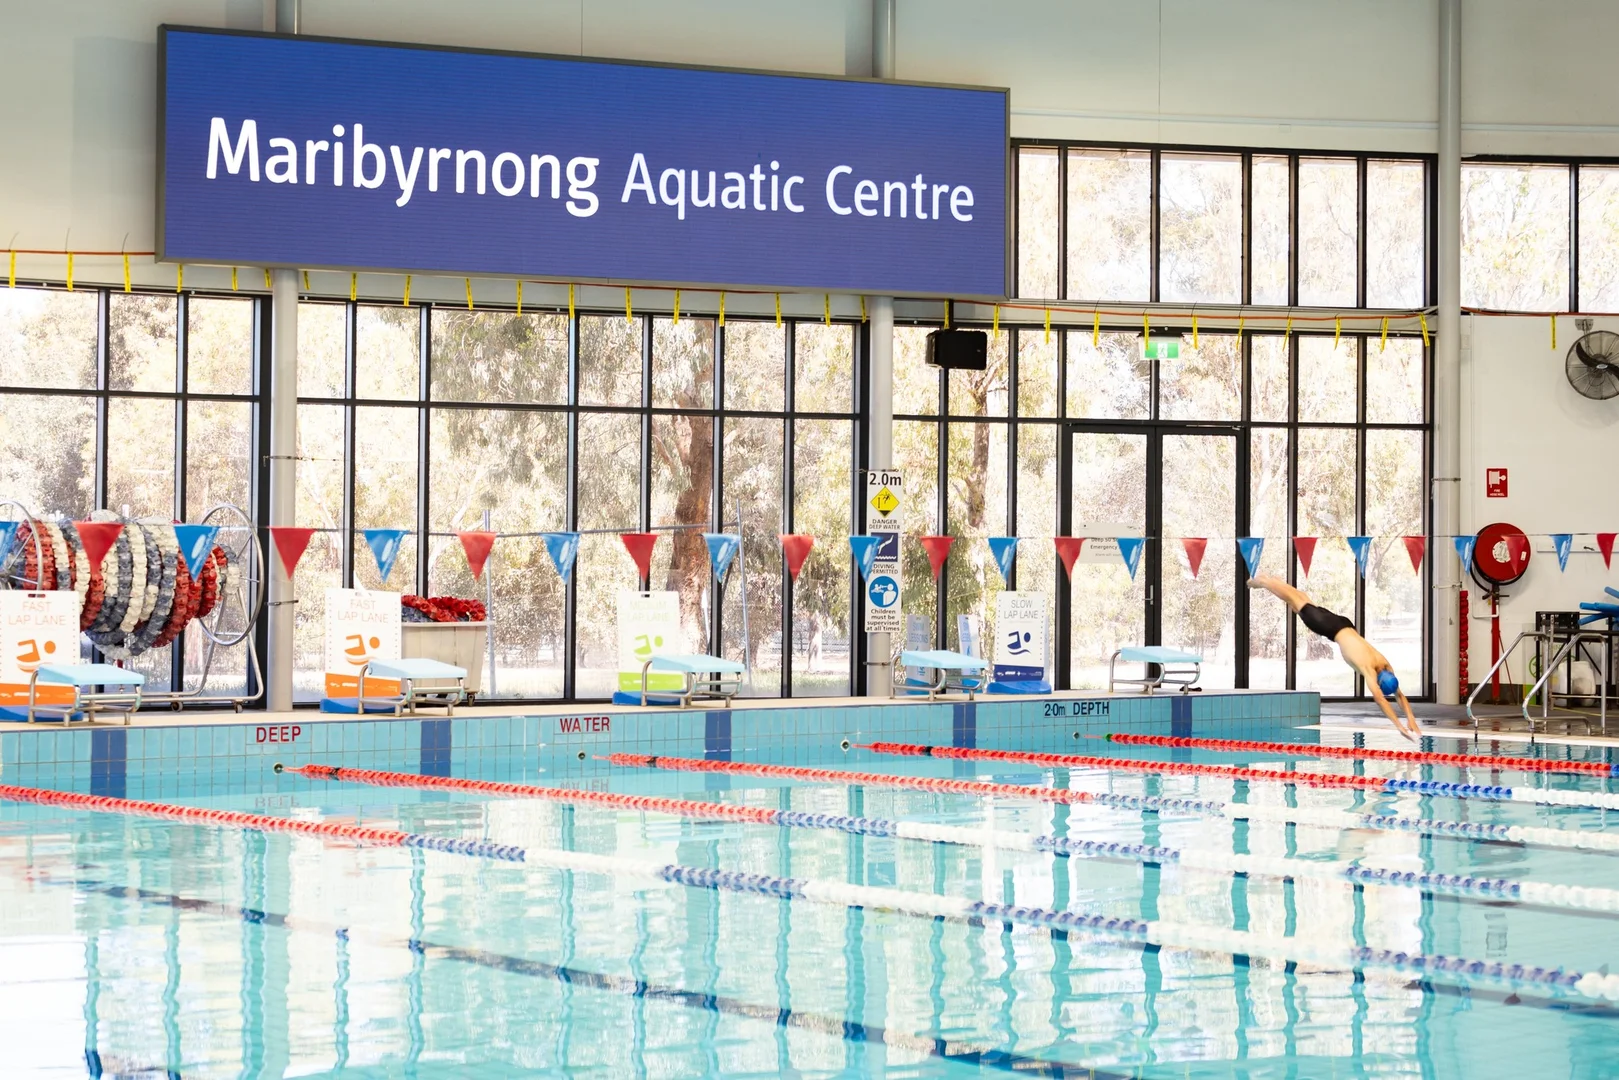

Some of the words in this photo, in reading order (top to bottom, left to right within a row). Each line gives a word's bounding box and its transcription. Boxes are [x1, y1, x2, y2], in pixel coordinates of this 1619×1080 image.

[206, 117, 600, 218] Maribyrnong
[621, 152, 805, 221] Aquatic
[825, 165, 975, 223] Centre
[869, 473, 902, 486] 2.0m
[22, 600, 52, 612] FAST
[350, 598, 377, 610] FAST
[1010, 599, 1033, 609] SLOW
[8, 614, 31, 626] LAP
[35, 614, 67, 626] LANE
[337, 610, 358, 621] LAP
[361, 611, 389, 623] LANE
[1003, 610, 1018, 619] LAP
[1021, 610, 1039, 620] LANE
[1073, 701, 1109, 716] DEPTH
[559, 716, 610, 733] WATER
[256, 725, 301, 743] DEEP
